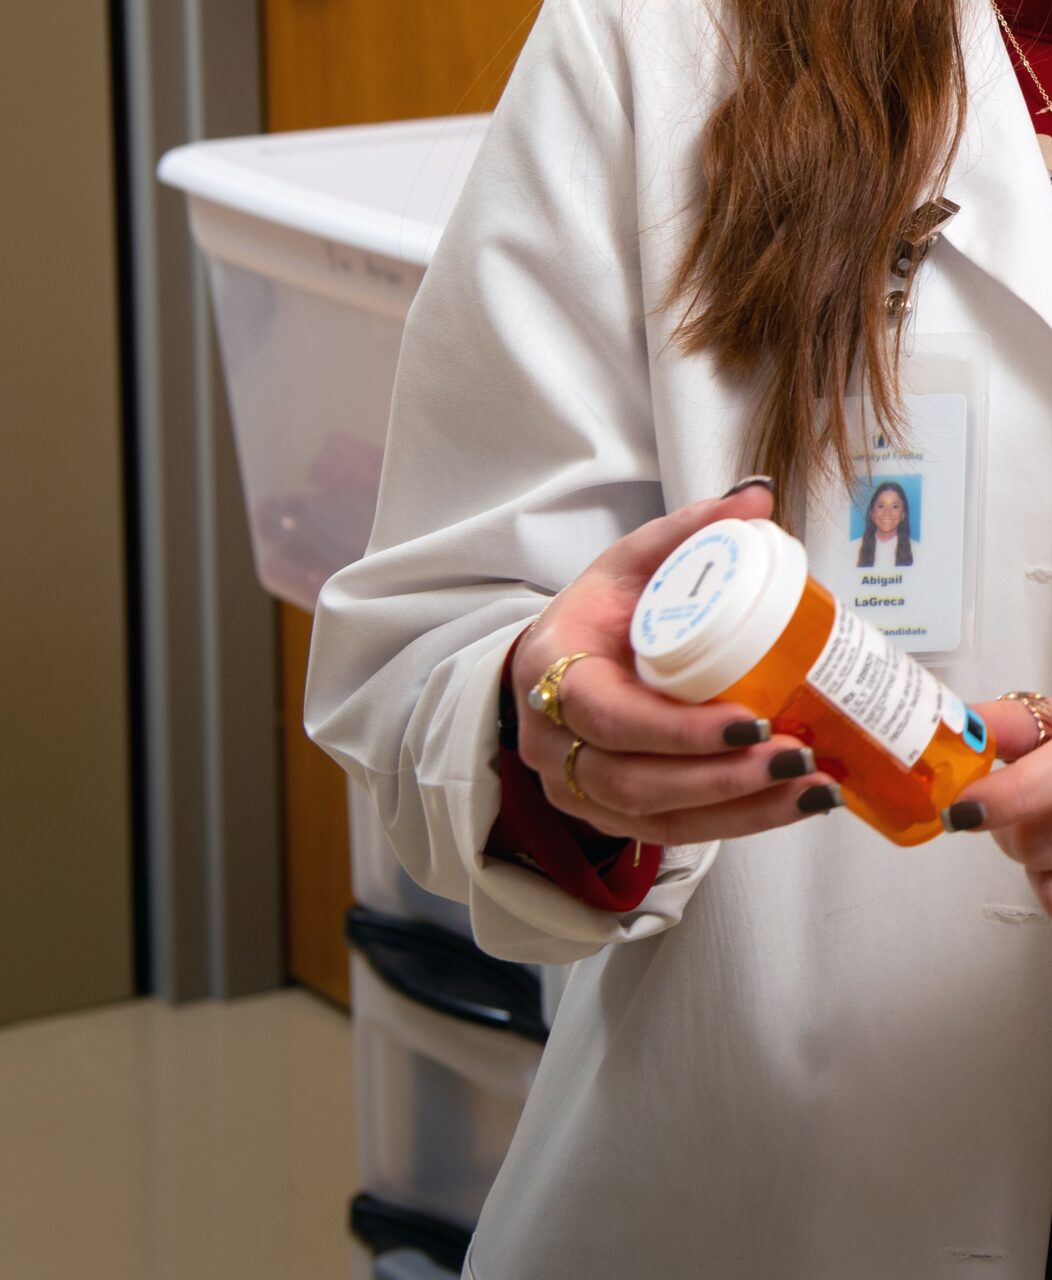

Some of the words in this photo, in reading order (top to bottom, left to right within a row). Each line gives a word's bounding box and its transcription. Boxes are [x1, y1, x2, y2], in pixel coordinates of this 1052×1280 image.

[861, 575, 903, 587] Abigail
[855, 597, 905, 607] LaGreca
[878, 627, 927, 637] andidate
